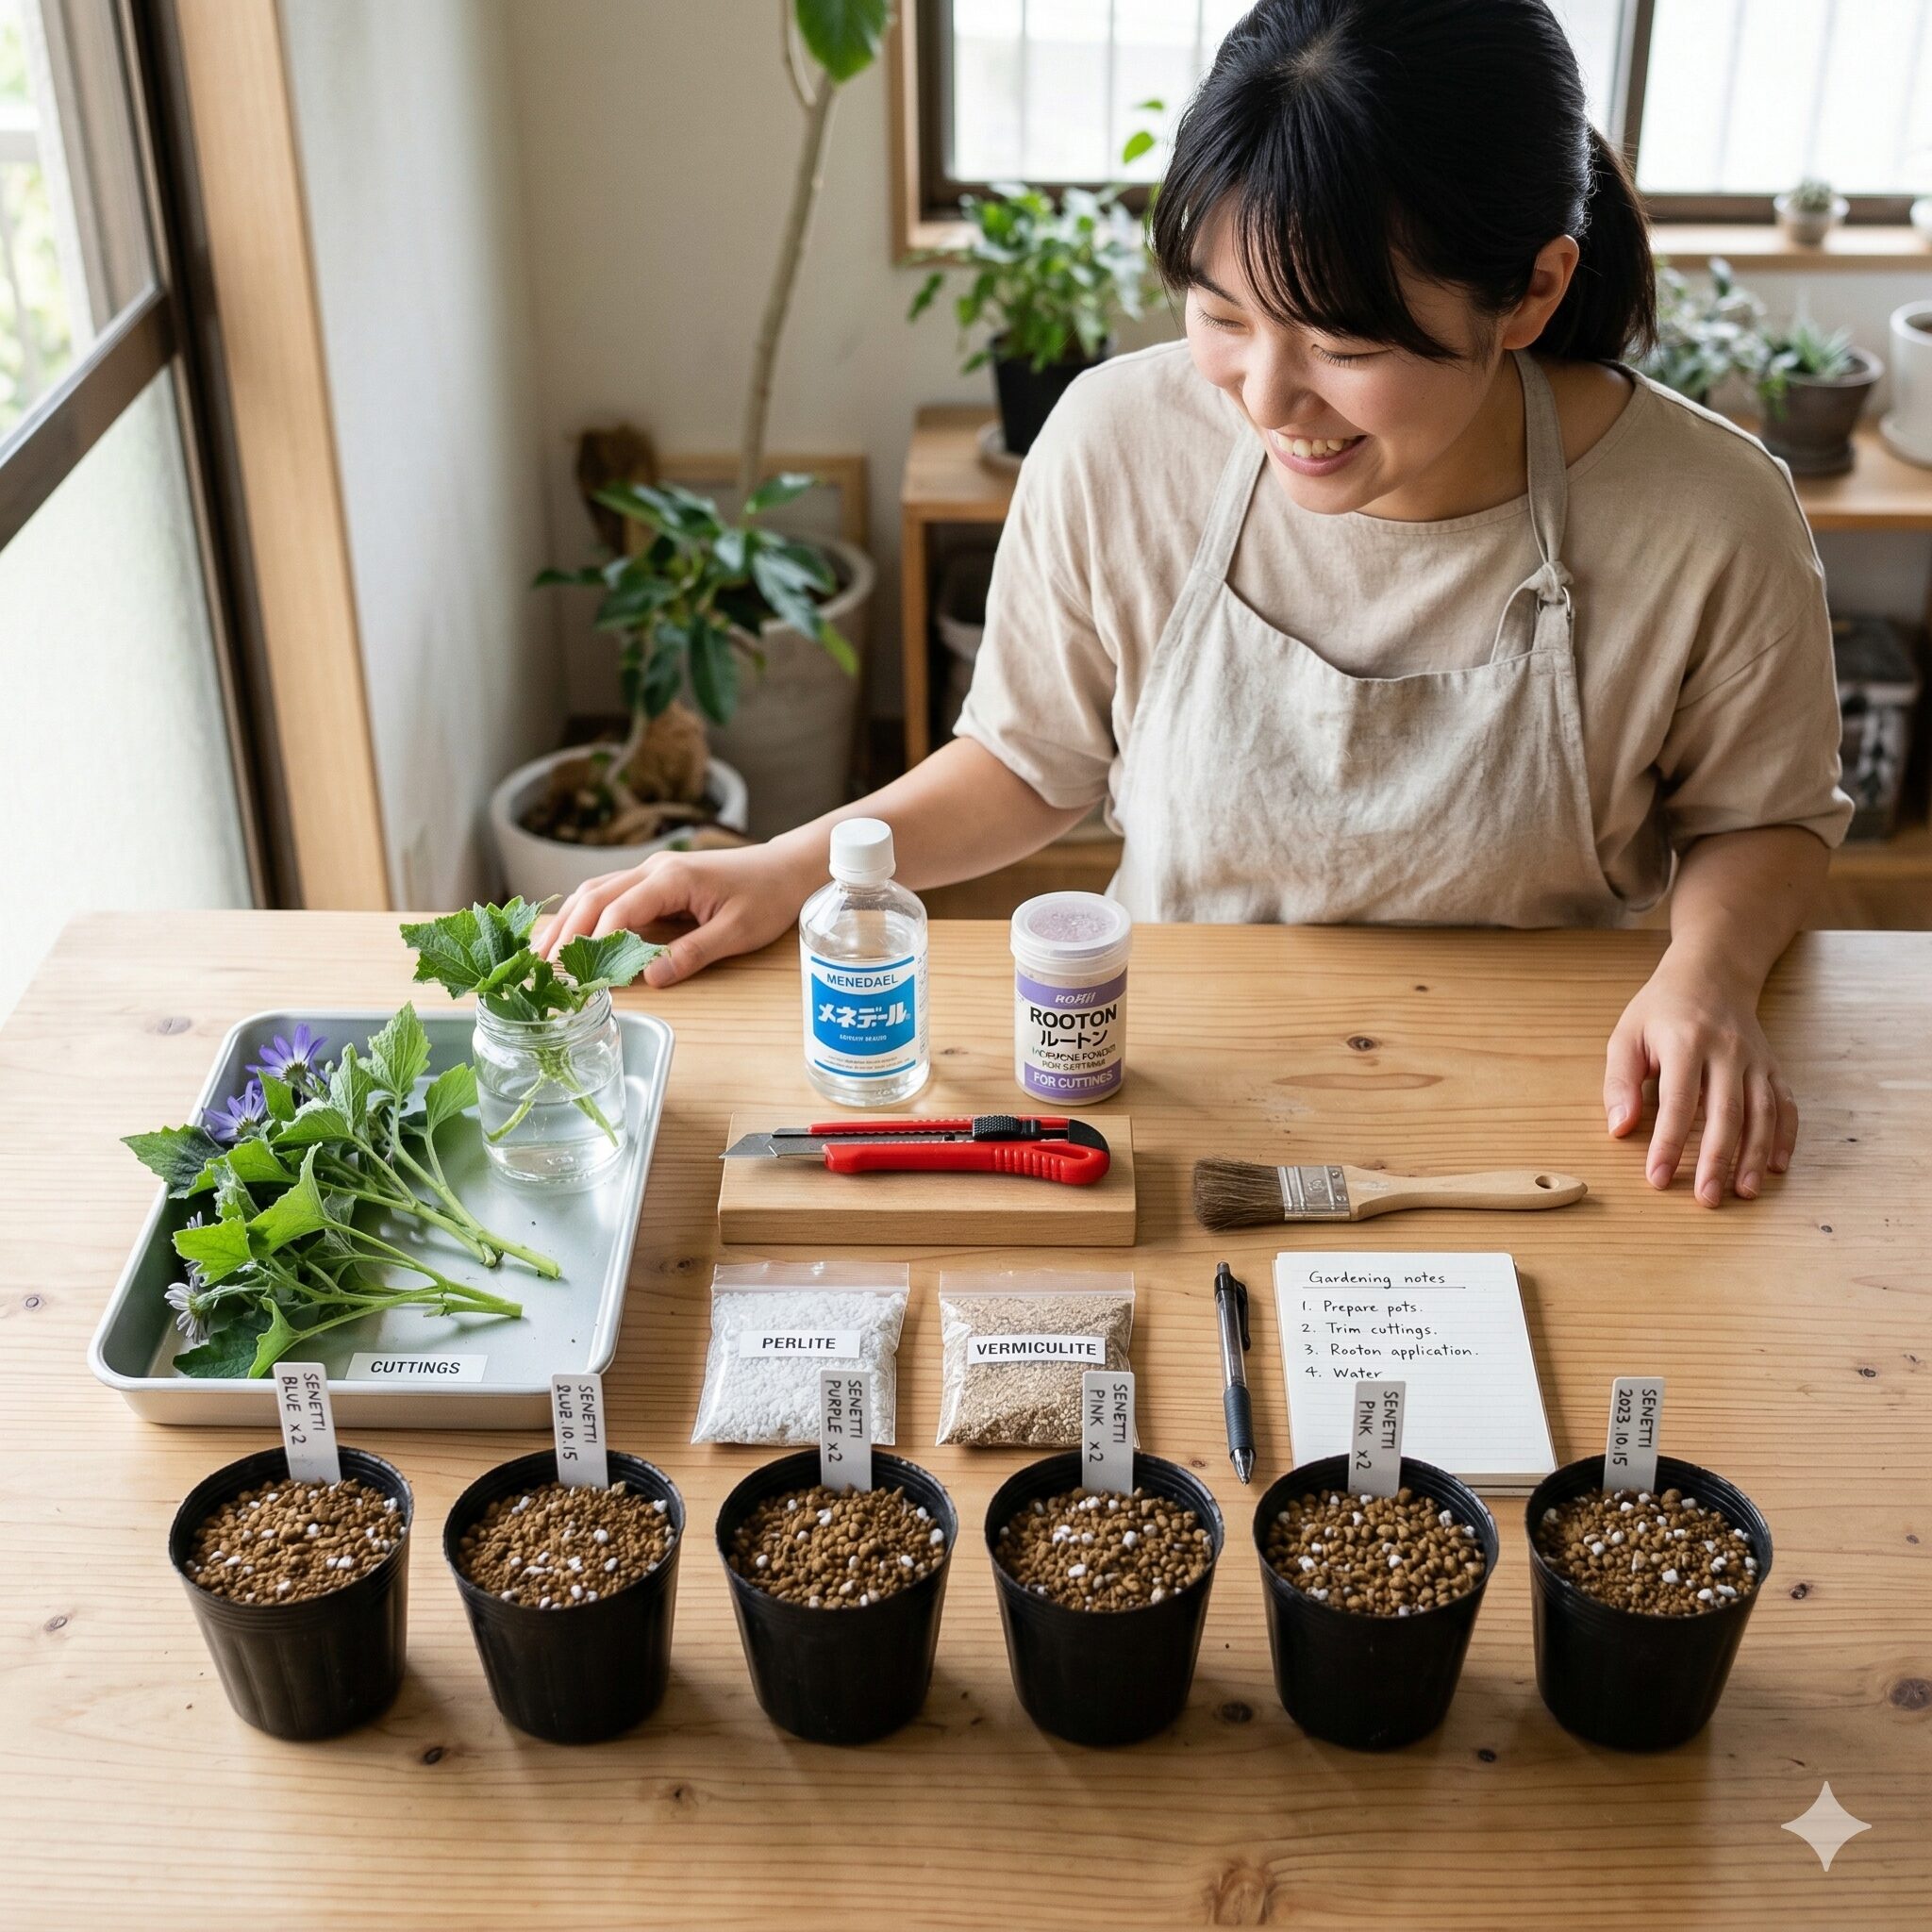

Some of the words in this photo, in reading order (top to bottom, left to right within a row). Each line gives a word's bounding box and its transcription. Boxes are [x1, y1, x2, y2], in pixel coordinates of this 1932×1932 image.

[826, 973, 899, 988] MENEDAEL
[818, 1001, 907, 1029] メネデール
[1030, 1004, 1117, 1030] ROOTON
[1041, 1029, 1108, 1049] ルートン
[1033, 1071, 1056, 1088] FOR
[1309, 1271, 1391, 1289] Gardening
[1404, 1272, 1445, 1283] notes
[1302, 1300, 1312, 1310] 1.
[1324, 1300, 1378, 1317] Prepare
[1388, 1300, 1423, 1317] pots.
[761, 1337, 836, 1349] PERLITE
[1301, 1324, 1316, 1333] 2.
[1325, 1322, 1360, 1334] Trim
[1371, 1323, 1438, 1340] cuttings.
[976, 1341, 1096, 1356] VERMICULITE
[1304, 1344, 1318, 1355] 3.
[1330, 1343, 1381, 1356] Rooton
[1391, 1344, 1479, 1360] application.
[371, 1360, 461, 1374] CUTTINGS
[1305, 1366, 1322, 1377] 4.
[1333, 1367, 1383, 1378] Water
[282, 1376, 301, 1411] BLUE
[303, 1373, 326, 1431] SENETTI
[825, 1380, 842, 1434] PURPLE
[578, 1384, 597, 1443] SENETTI
[848, 1379, 863, 1438] SENETTI
[1090, 1390, 1106, 1426] PINK
[1113, 1383, 1127, 1443] SENETTI
[1358, 1401, 1375, 1436] PINK
[1381, 1391, 1399, 1449] SENETTI
[1638, 1389, 1657, 1448] SENETTI
[1612, 1389, 1633, 1466] 2023.10.15
